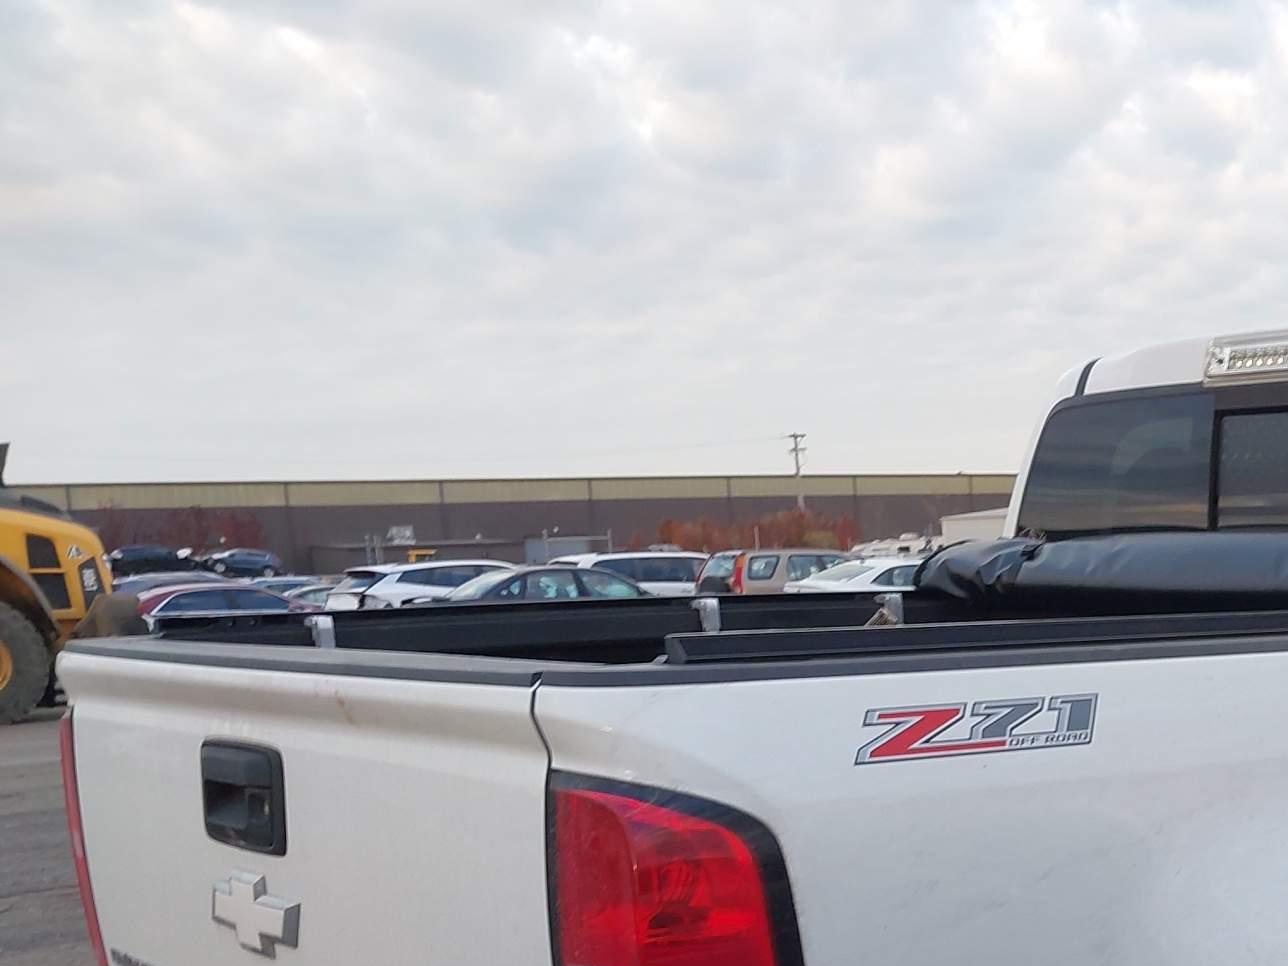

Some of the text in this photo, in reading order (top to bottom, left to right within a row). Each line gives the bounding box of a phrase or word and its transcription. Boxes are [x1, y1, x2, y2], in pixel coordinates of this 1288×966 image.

[855, 693, 1098, 765] Z71
[1007, 731, 1089, 748] OFF ROAD
